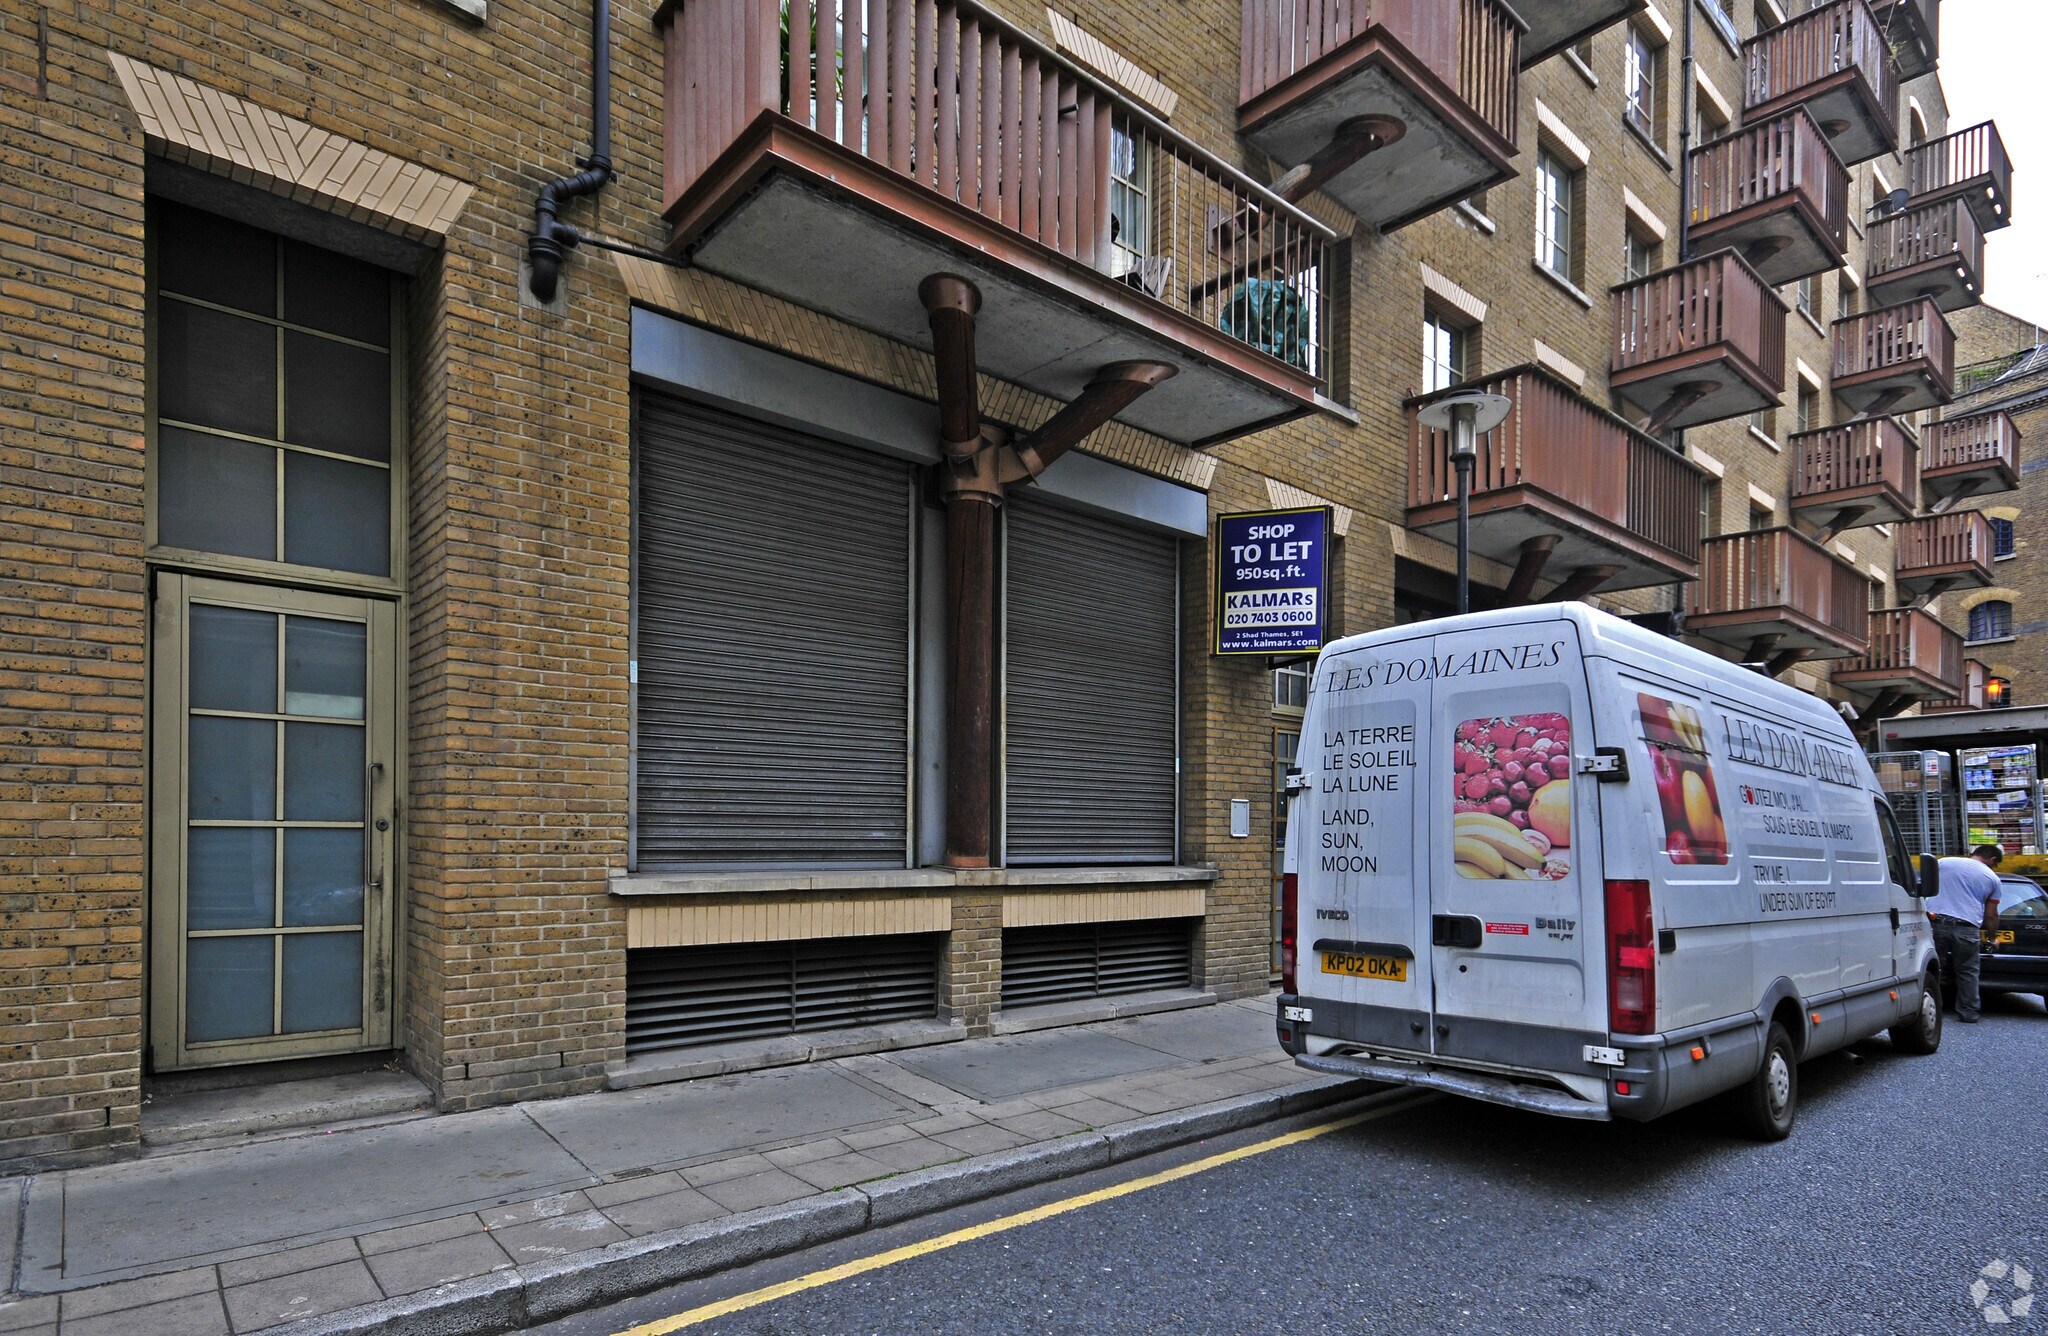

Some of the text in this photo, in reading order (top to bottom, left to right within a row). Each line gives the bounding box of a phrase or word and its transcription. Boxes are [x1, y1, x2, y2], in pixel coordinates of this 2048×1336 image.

[1248, 524, 1295, 540] SHOP
[1231, 541, 1313, 564] TO LET
[1227, 611, 1313, 625] 020 7403 0600
[1222, 639, 1318, 648] www.kalmars.com
[1326, 641, 1565, 693] LES DOMAINES
[1324, 725, 1413, 748] LA TERRE
[1721, 714, 1858, 787] LES DOMAINES
[1323, 750, 1417, 771] LE SOLEIL,
[1322, 774, 1399, 793] LA LUNE
[1322, 809, 1375, 828] LAND,
[1763, 815, 1786, 834] SOUS
[1786, 818, 1798, 836] LE
[1797, 820, 1821, 837] SOLEIL
[1830, 823, 1853, 840] MAROC
[1322, 832, 1363, 851] SUN,
[1322, 856, 1377, 873] MOON
[1754, 865, 1770, 883] TRY
[1760, 891, 1836, 912] UNDER SUN OF EGYPT
[1316, 909, 1349, 920] IVECO
[1535, 917, 1576, 930] Daily
[1327, 954, 1398, 976] KP02 OKA
